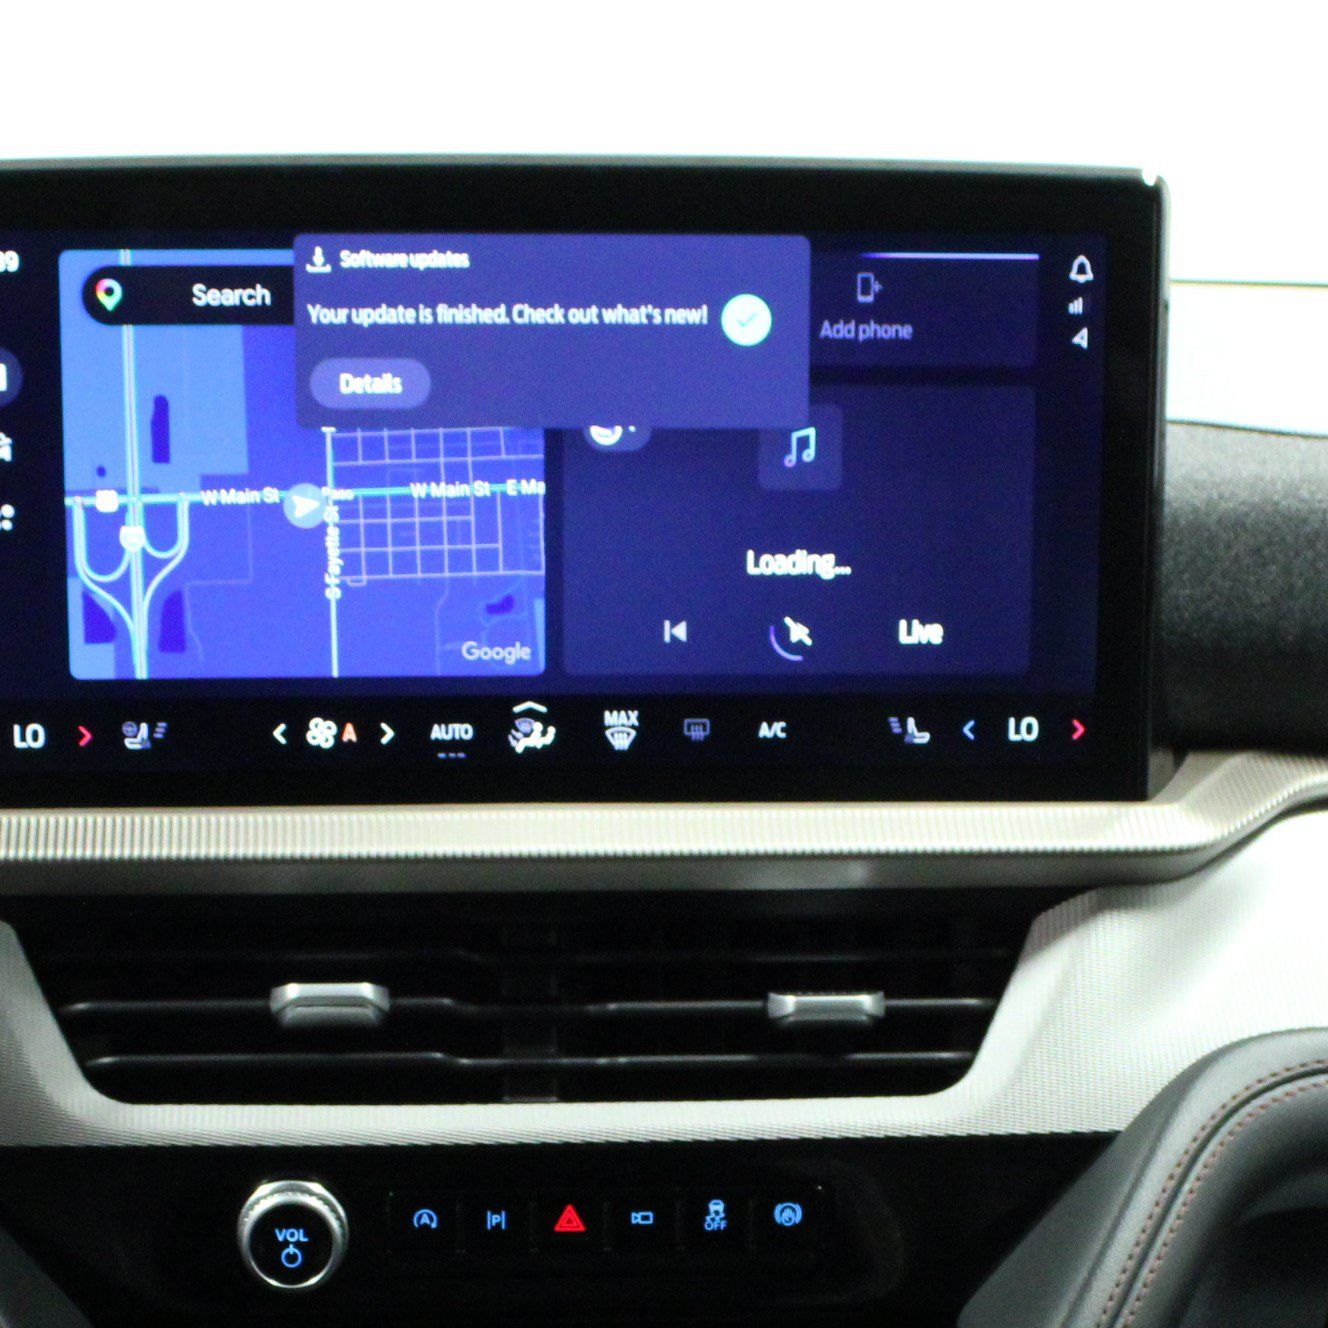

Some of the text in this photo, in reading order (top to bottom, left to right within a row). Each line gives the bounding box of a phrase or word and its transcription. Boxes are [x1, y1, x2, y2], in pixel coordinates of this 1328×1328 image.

[339, 249, 470, 272] Software updates
[192, 283, 272, 307] Search
[307, 303, 708, 327] Your update is finished. Check out what's new!
[820, 320, 913, 343] Add phone
[339, 372, 403, 395] Details
[200, 486, 280, 506] W Main St
[410, 480, 491, 498] W Main St
[506, 479, 518, 496] E
[898, 618, 944, 645] Live
[461, 640, 531, 664] Google
[603, 710, 639, 727] MAX
[758, 721, 787, 739] A/C
[1008, 717, 1040, 741] LO
[13, 722, 46, 748] LO
[430, 723, 473, 741] AUTO
[275, 1228, 309, 1243] VOL
[704, 1220, 728, 1231] OFF
